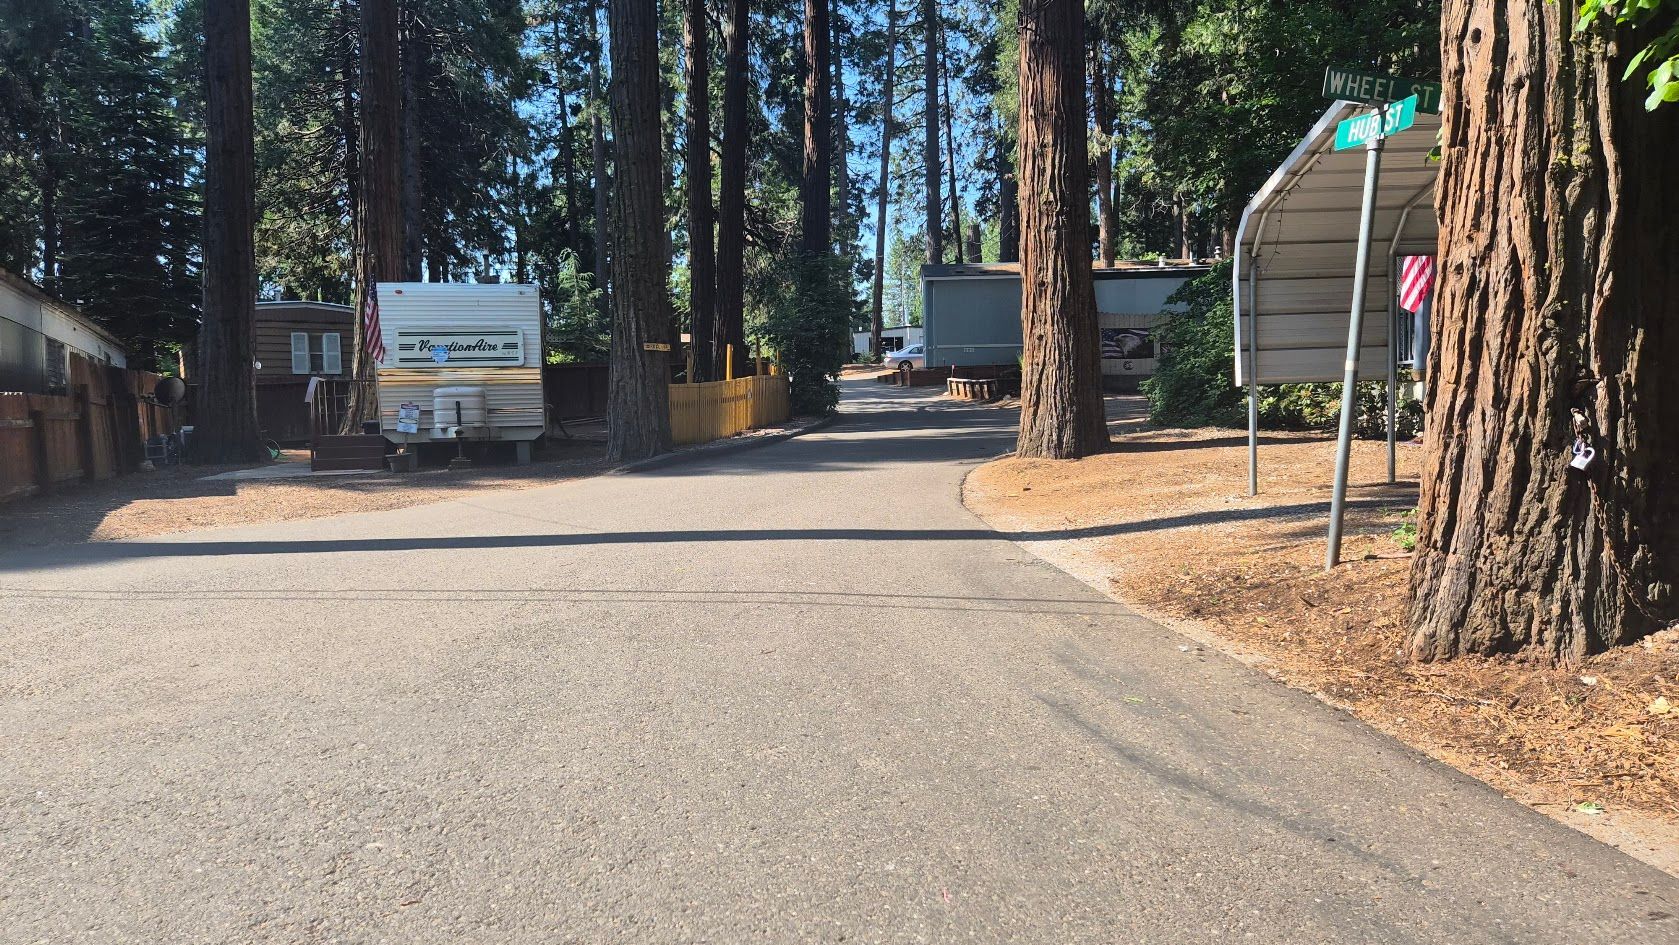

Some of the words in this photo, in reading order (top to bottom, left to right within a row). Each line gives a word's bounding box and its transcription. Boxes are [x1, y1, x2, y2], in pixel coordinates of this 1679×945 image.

[1330, 70, 1397, 102] WHEEL
[1347, 114, 1381, 143] HUB
[1384, 103, 1404, 132] ST
